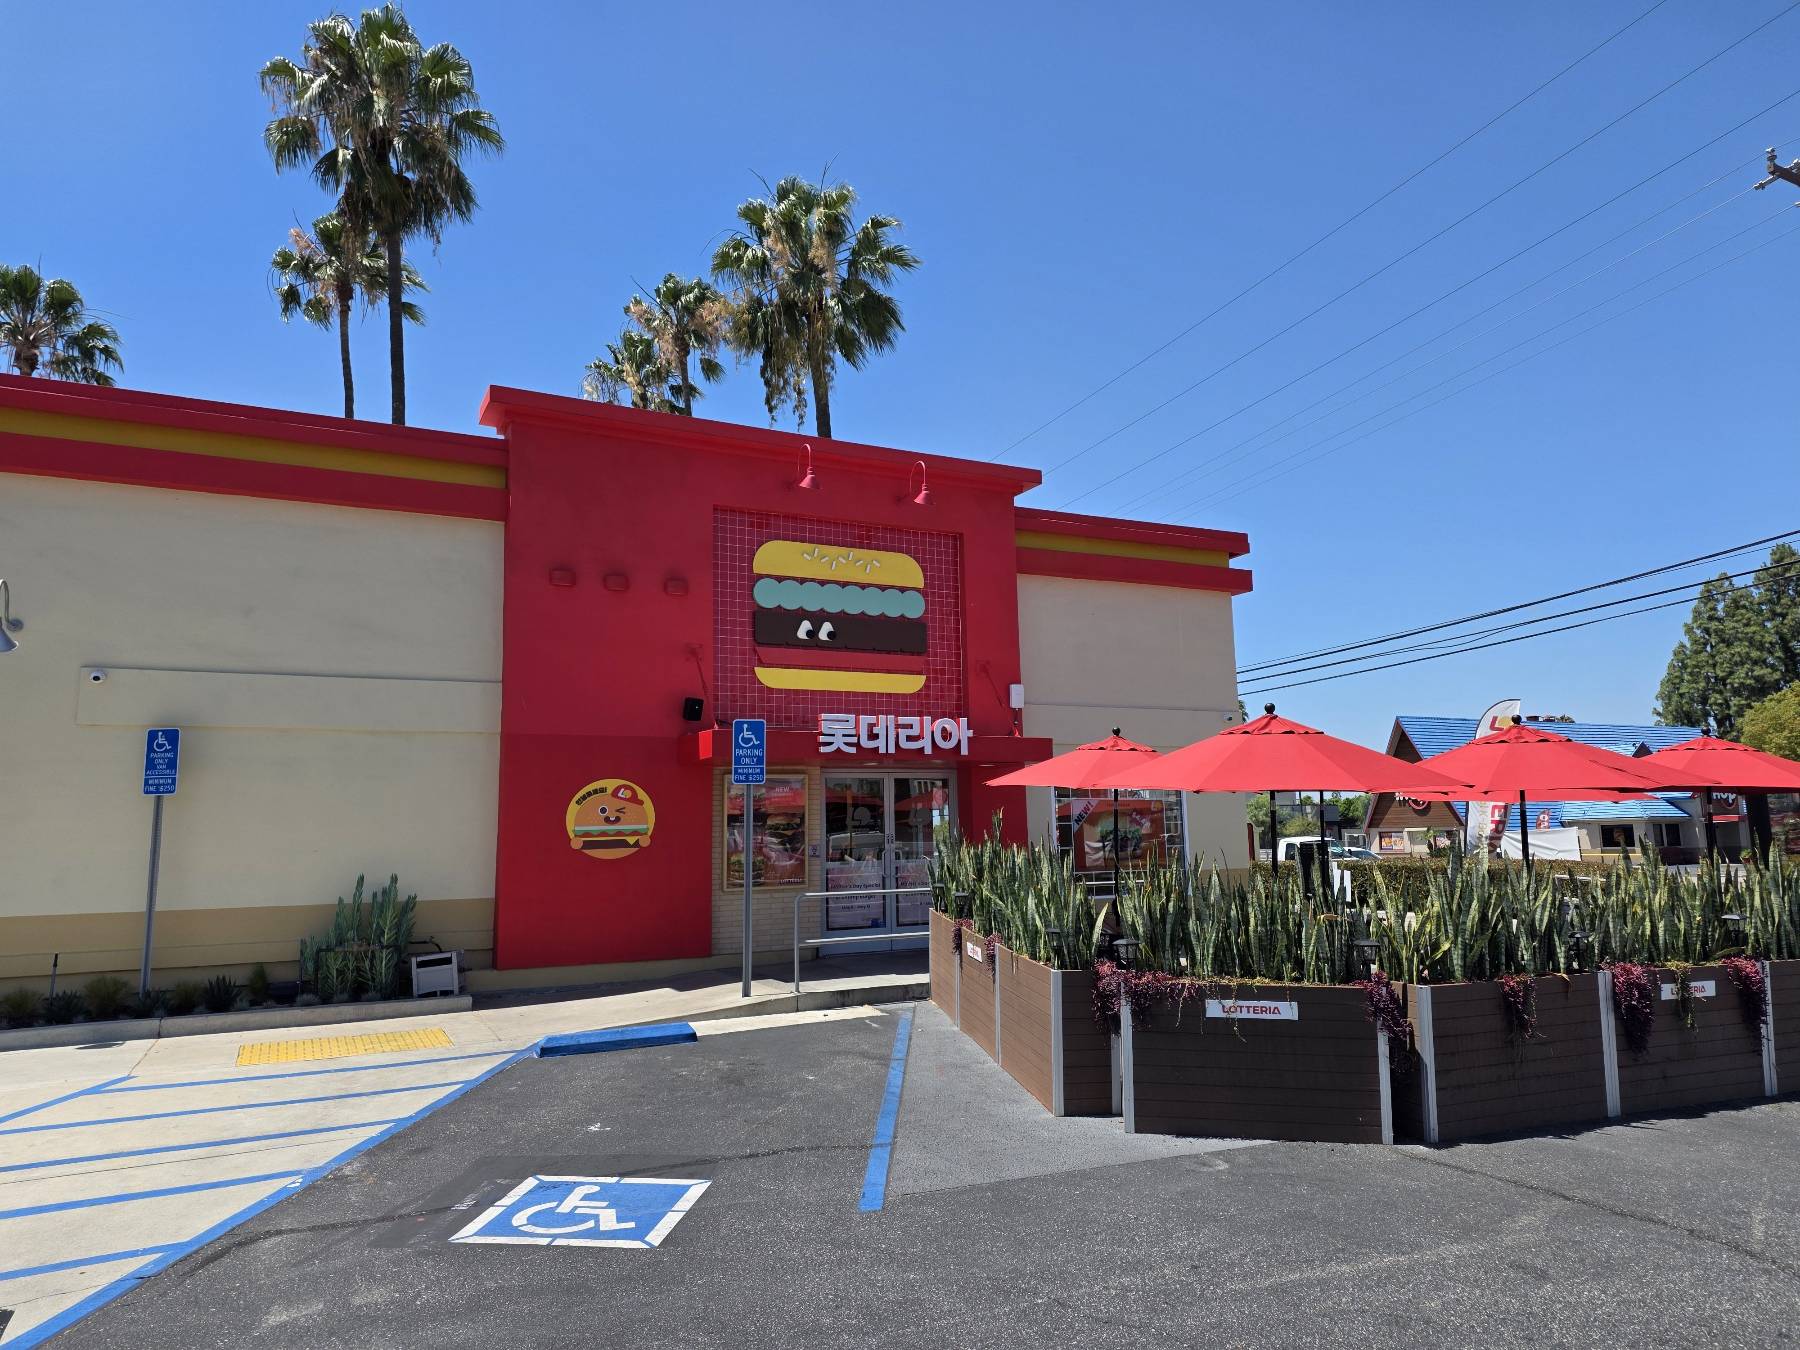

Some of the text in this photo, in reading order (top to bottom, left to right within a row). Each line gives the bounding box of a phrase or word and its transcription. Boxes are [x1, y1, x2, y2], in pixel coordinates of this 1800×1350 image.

[819, 713, 974, 755] 롯데리아
[736, 749, 763, 757] PARKING
[740, 757, 757, 765] ONLY
[1074, 801, 1095, 826] NEW!
[1221, 1004, 1282, 1016] LOTTERIA
